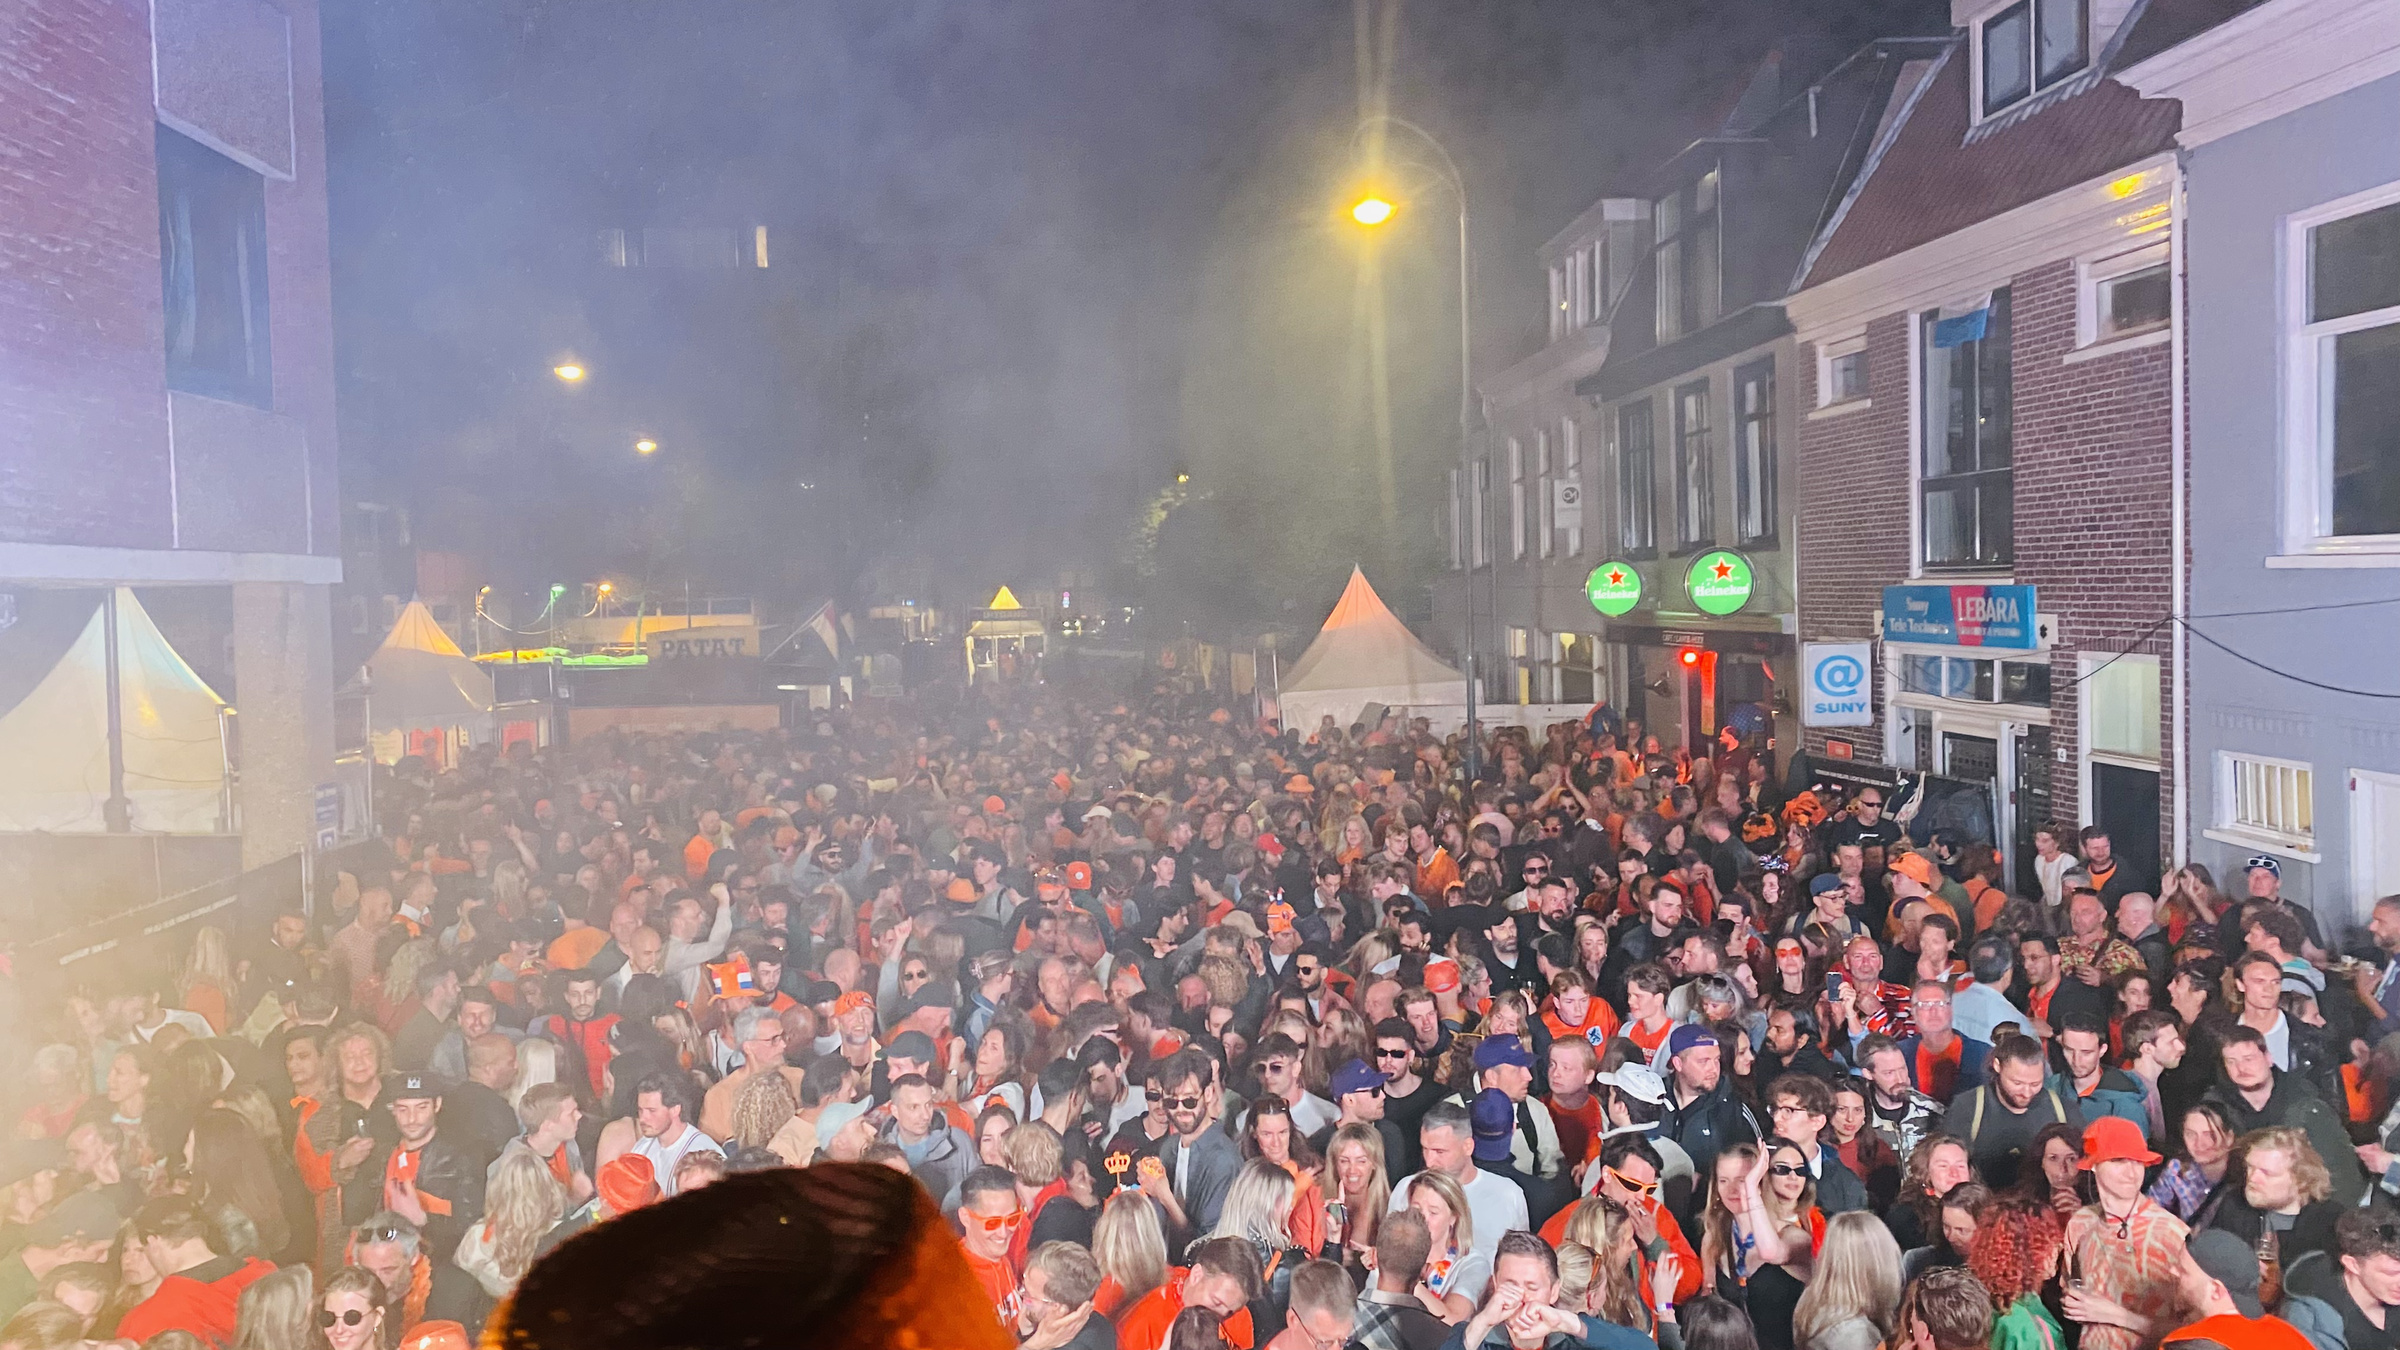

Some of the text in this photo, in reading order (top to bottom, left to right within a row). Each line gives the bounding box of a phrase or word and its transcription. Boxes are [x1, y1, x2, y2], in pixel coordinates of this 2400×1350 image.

[1593, 588, 1639, 599] Heineken
[1695, 583, 1750, 597] Heineken
[1957, 596, 2020, 623] LEBARA
[660, 638, 745, 657] PATAT
[1814, 702, 1866, 713] SUNY
